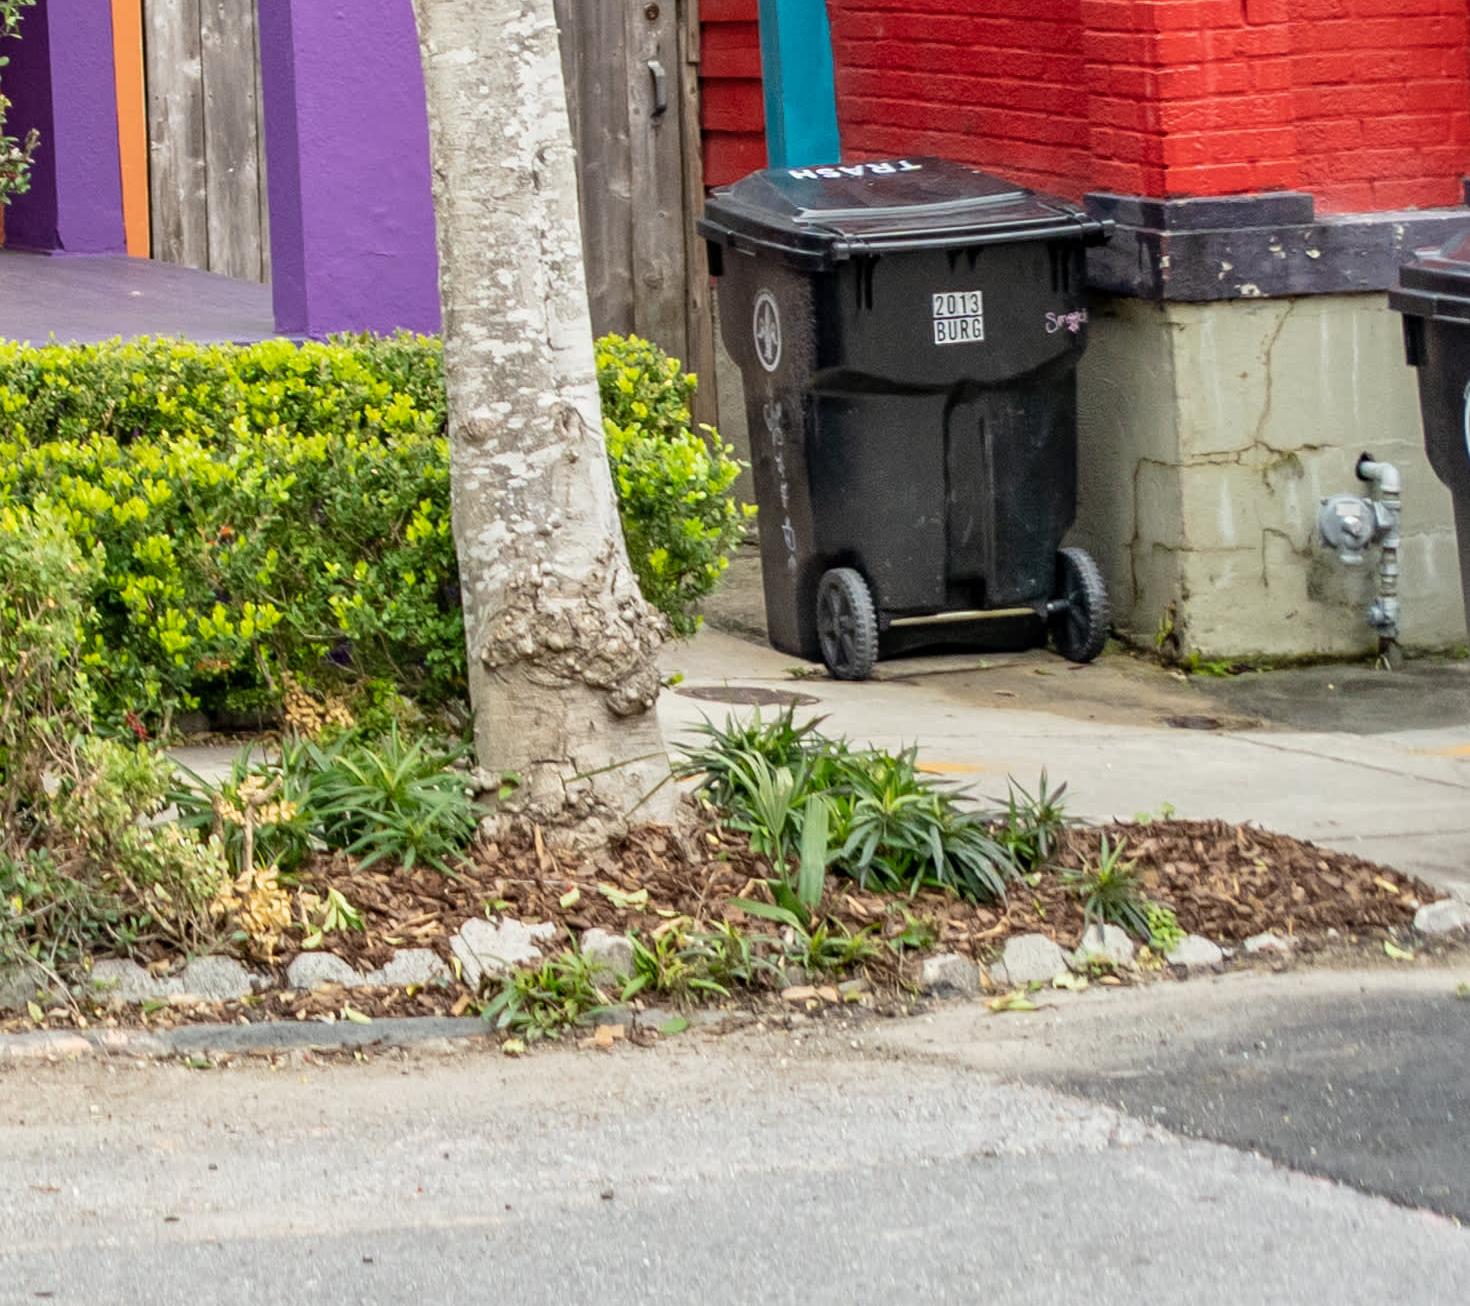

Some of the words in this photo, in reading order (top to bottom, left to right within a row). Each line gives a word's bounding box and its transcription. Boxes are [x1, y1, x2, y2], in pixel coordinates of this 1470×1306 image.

[788, 159, 923, 180] TRASH
[935, 293, 980, 316] 2013
[937, 318, 982, 342] BURG
